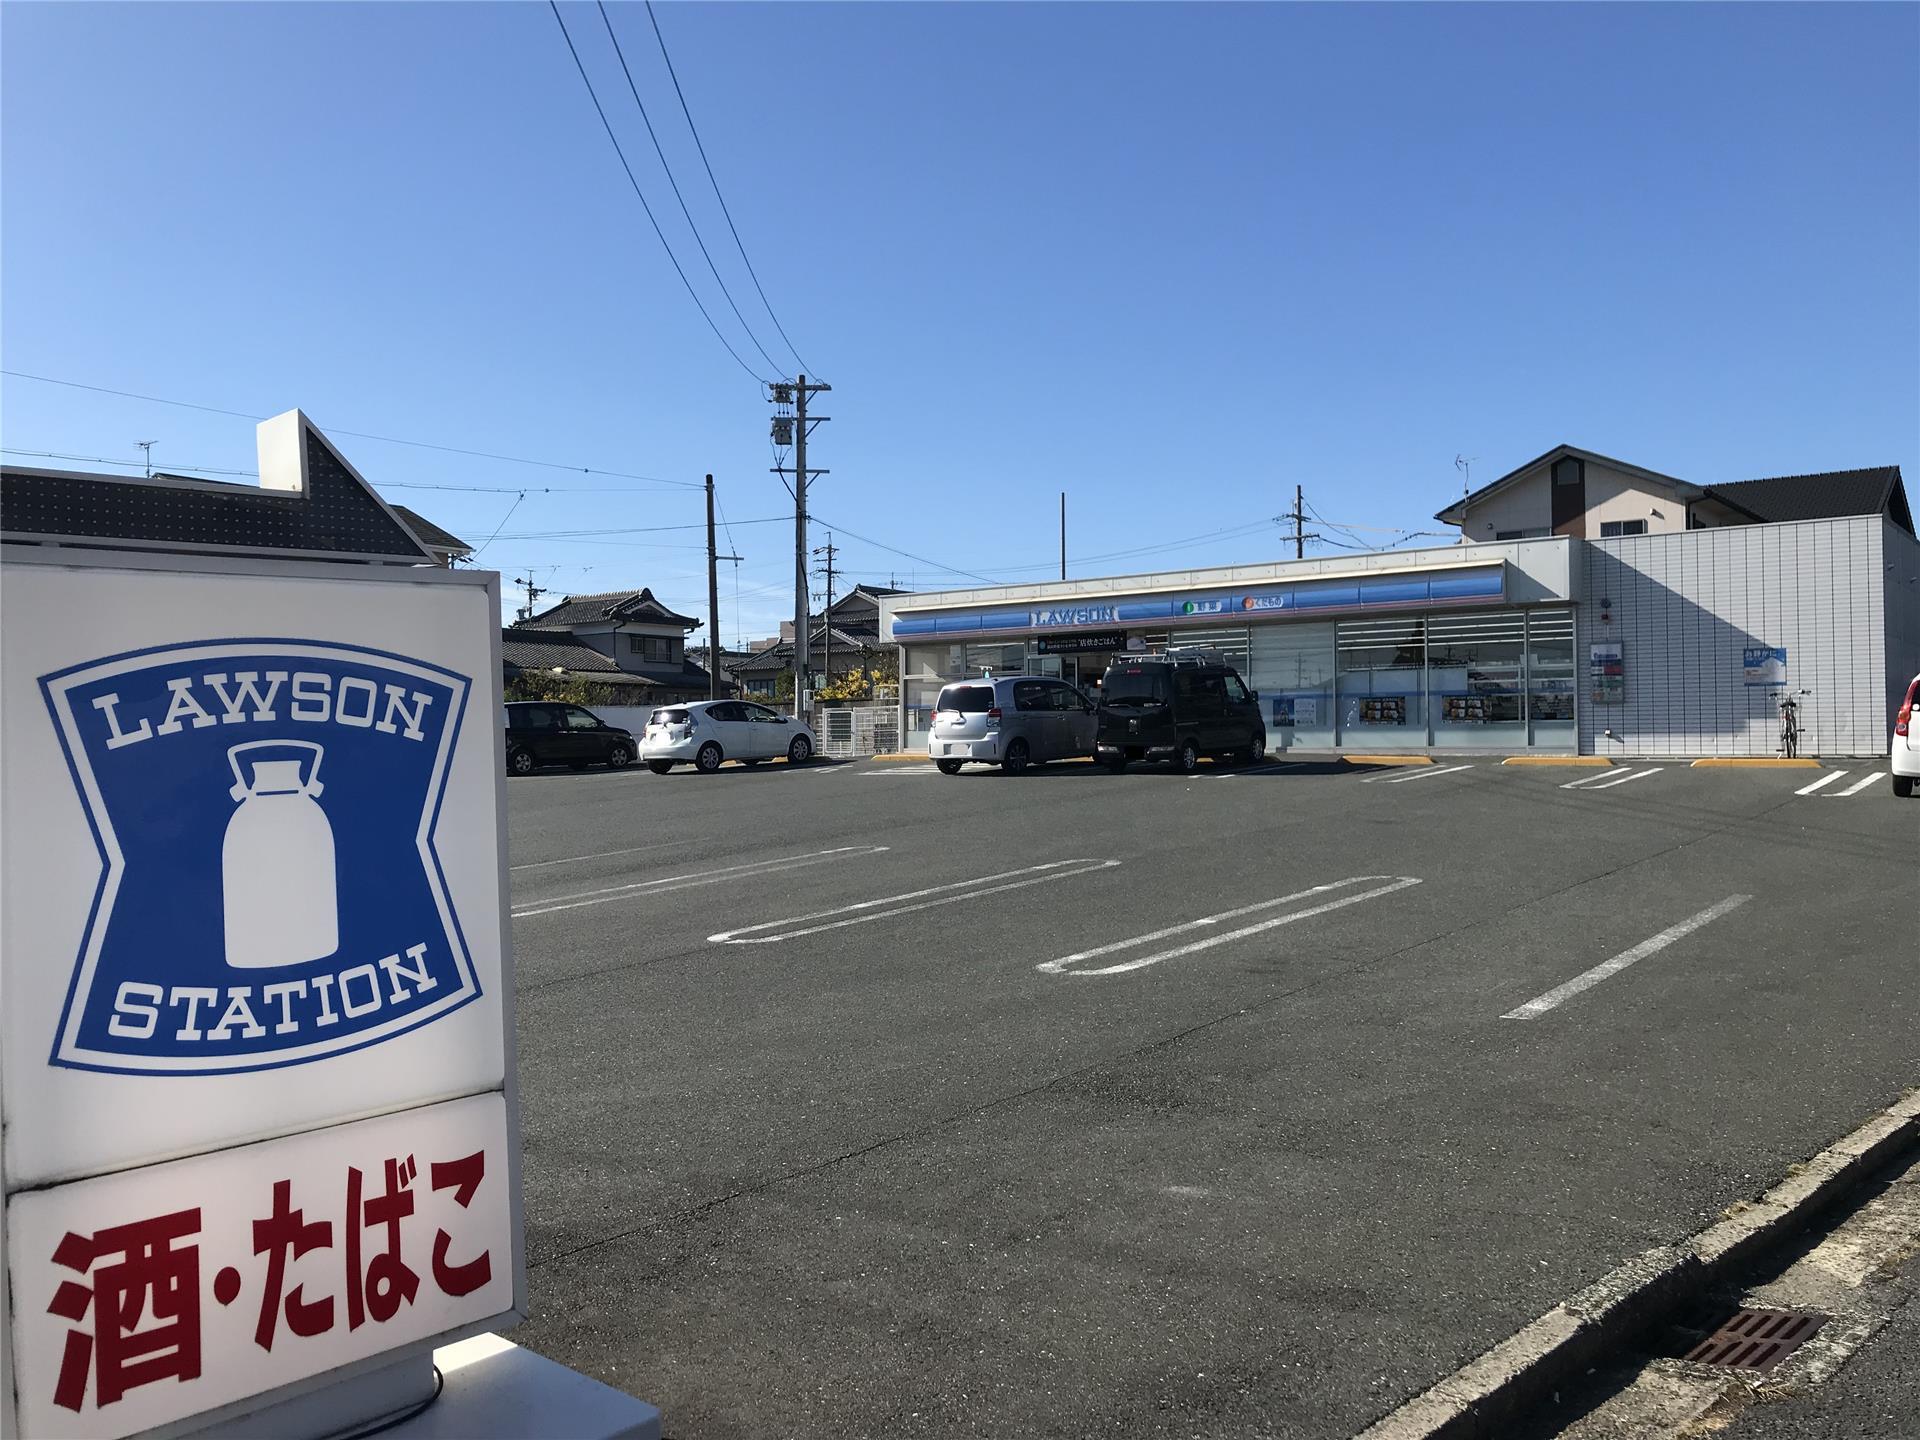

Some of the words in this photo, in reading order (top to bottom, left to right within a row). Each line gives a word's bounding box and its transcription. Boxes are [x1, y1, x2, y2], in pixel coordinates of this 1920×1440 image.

[1035, 605, 1115, 625] LAWSON
[91, 671, 433, 750] LAWSON
[108, 942, 438, 1041] STATION
